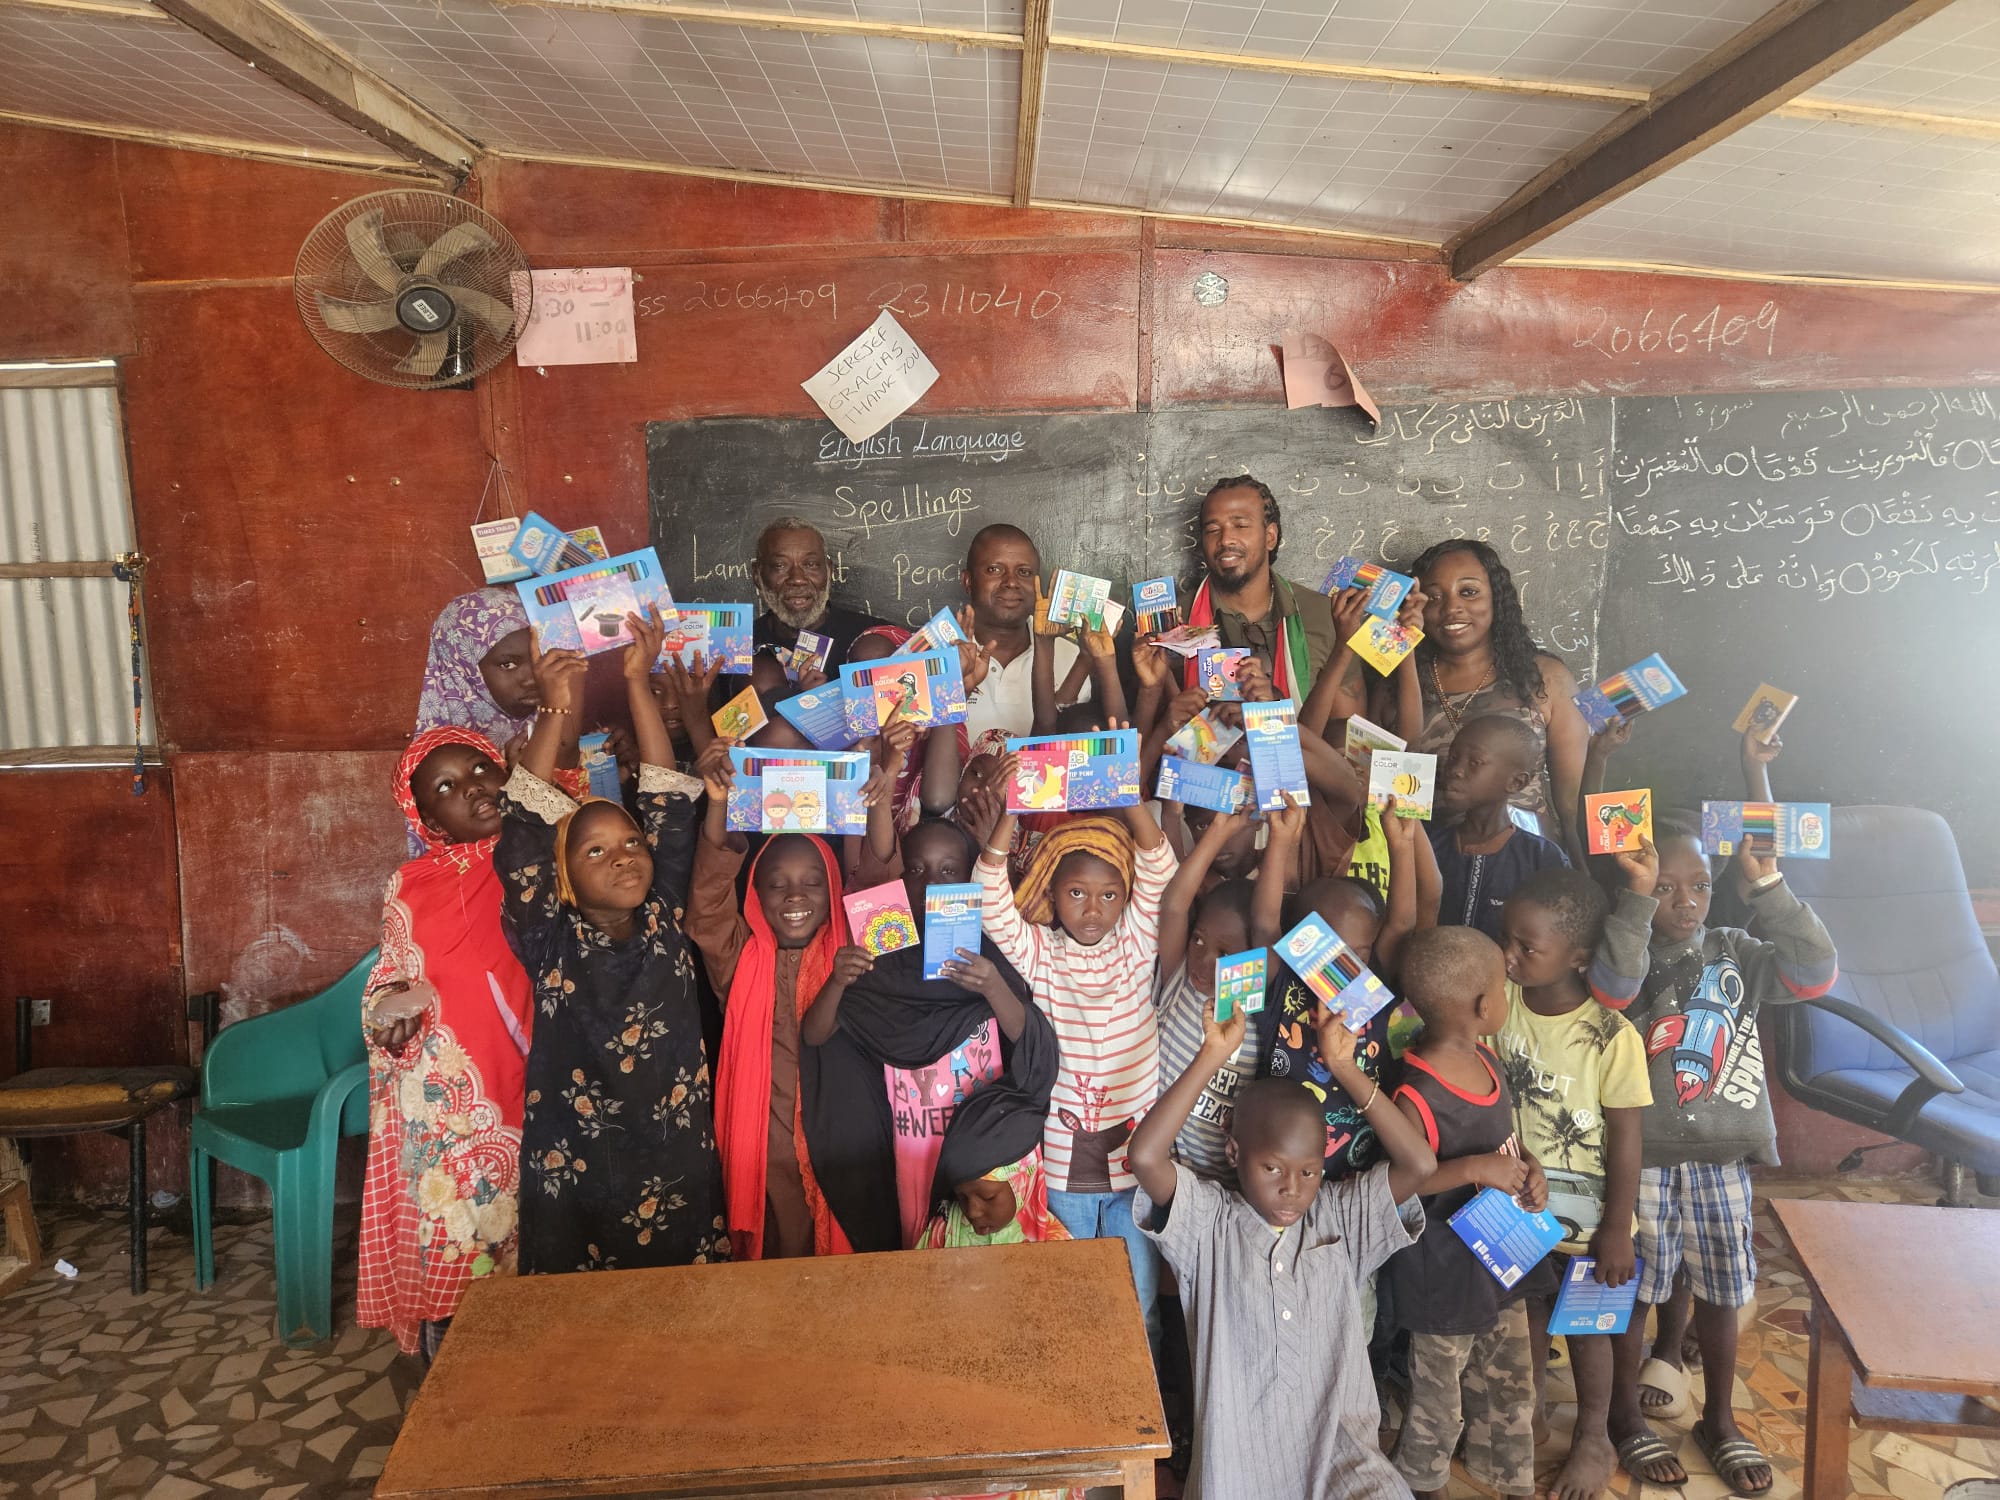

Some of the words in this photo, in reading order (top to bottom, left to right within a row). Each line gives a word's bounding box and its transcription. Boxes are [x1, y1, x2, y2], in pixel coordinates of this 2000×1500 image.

[683, 280, 838, 320] 2066709
[866, 281, 1063, 320] 2311040
[825, 326, 888, 385] JEREJEF
[828, 340, 903, 411] GRACIAS
[843, 374, 897, 424] THANK
[896, 346, 921, 375] YOU
[819, 421, 902, 470] English
[912, 419, 1027, 463] Language
[832, 482, 974, 539] Spellings
[891, 553, 962, 601] Penci
[1373, 760, 1398, 769] COLOR
[1713, 1042, 1743, 1096] ADVENTURE
